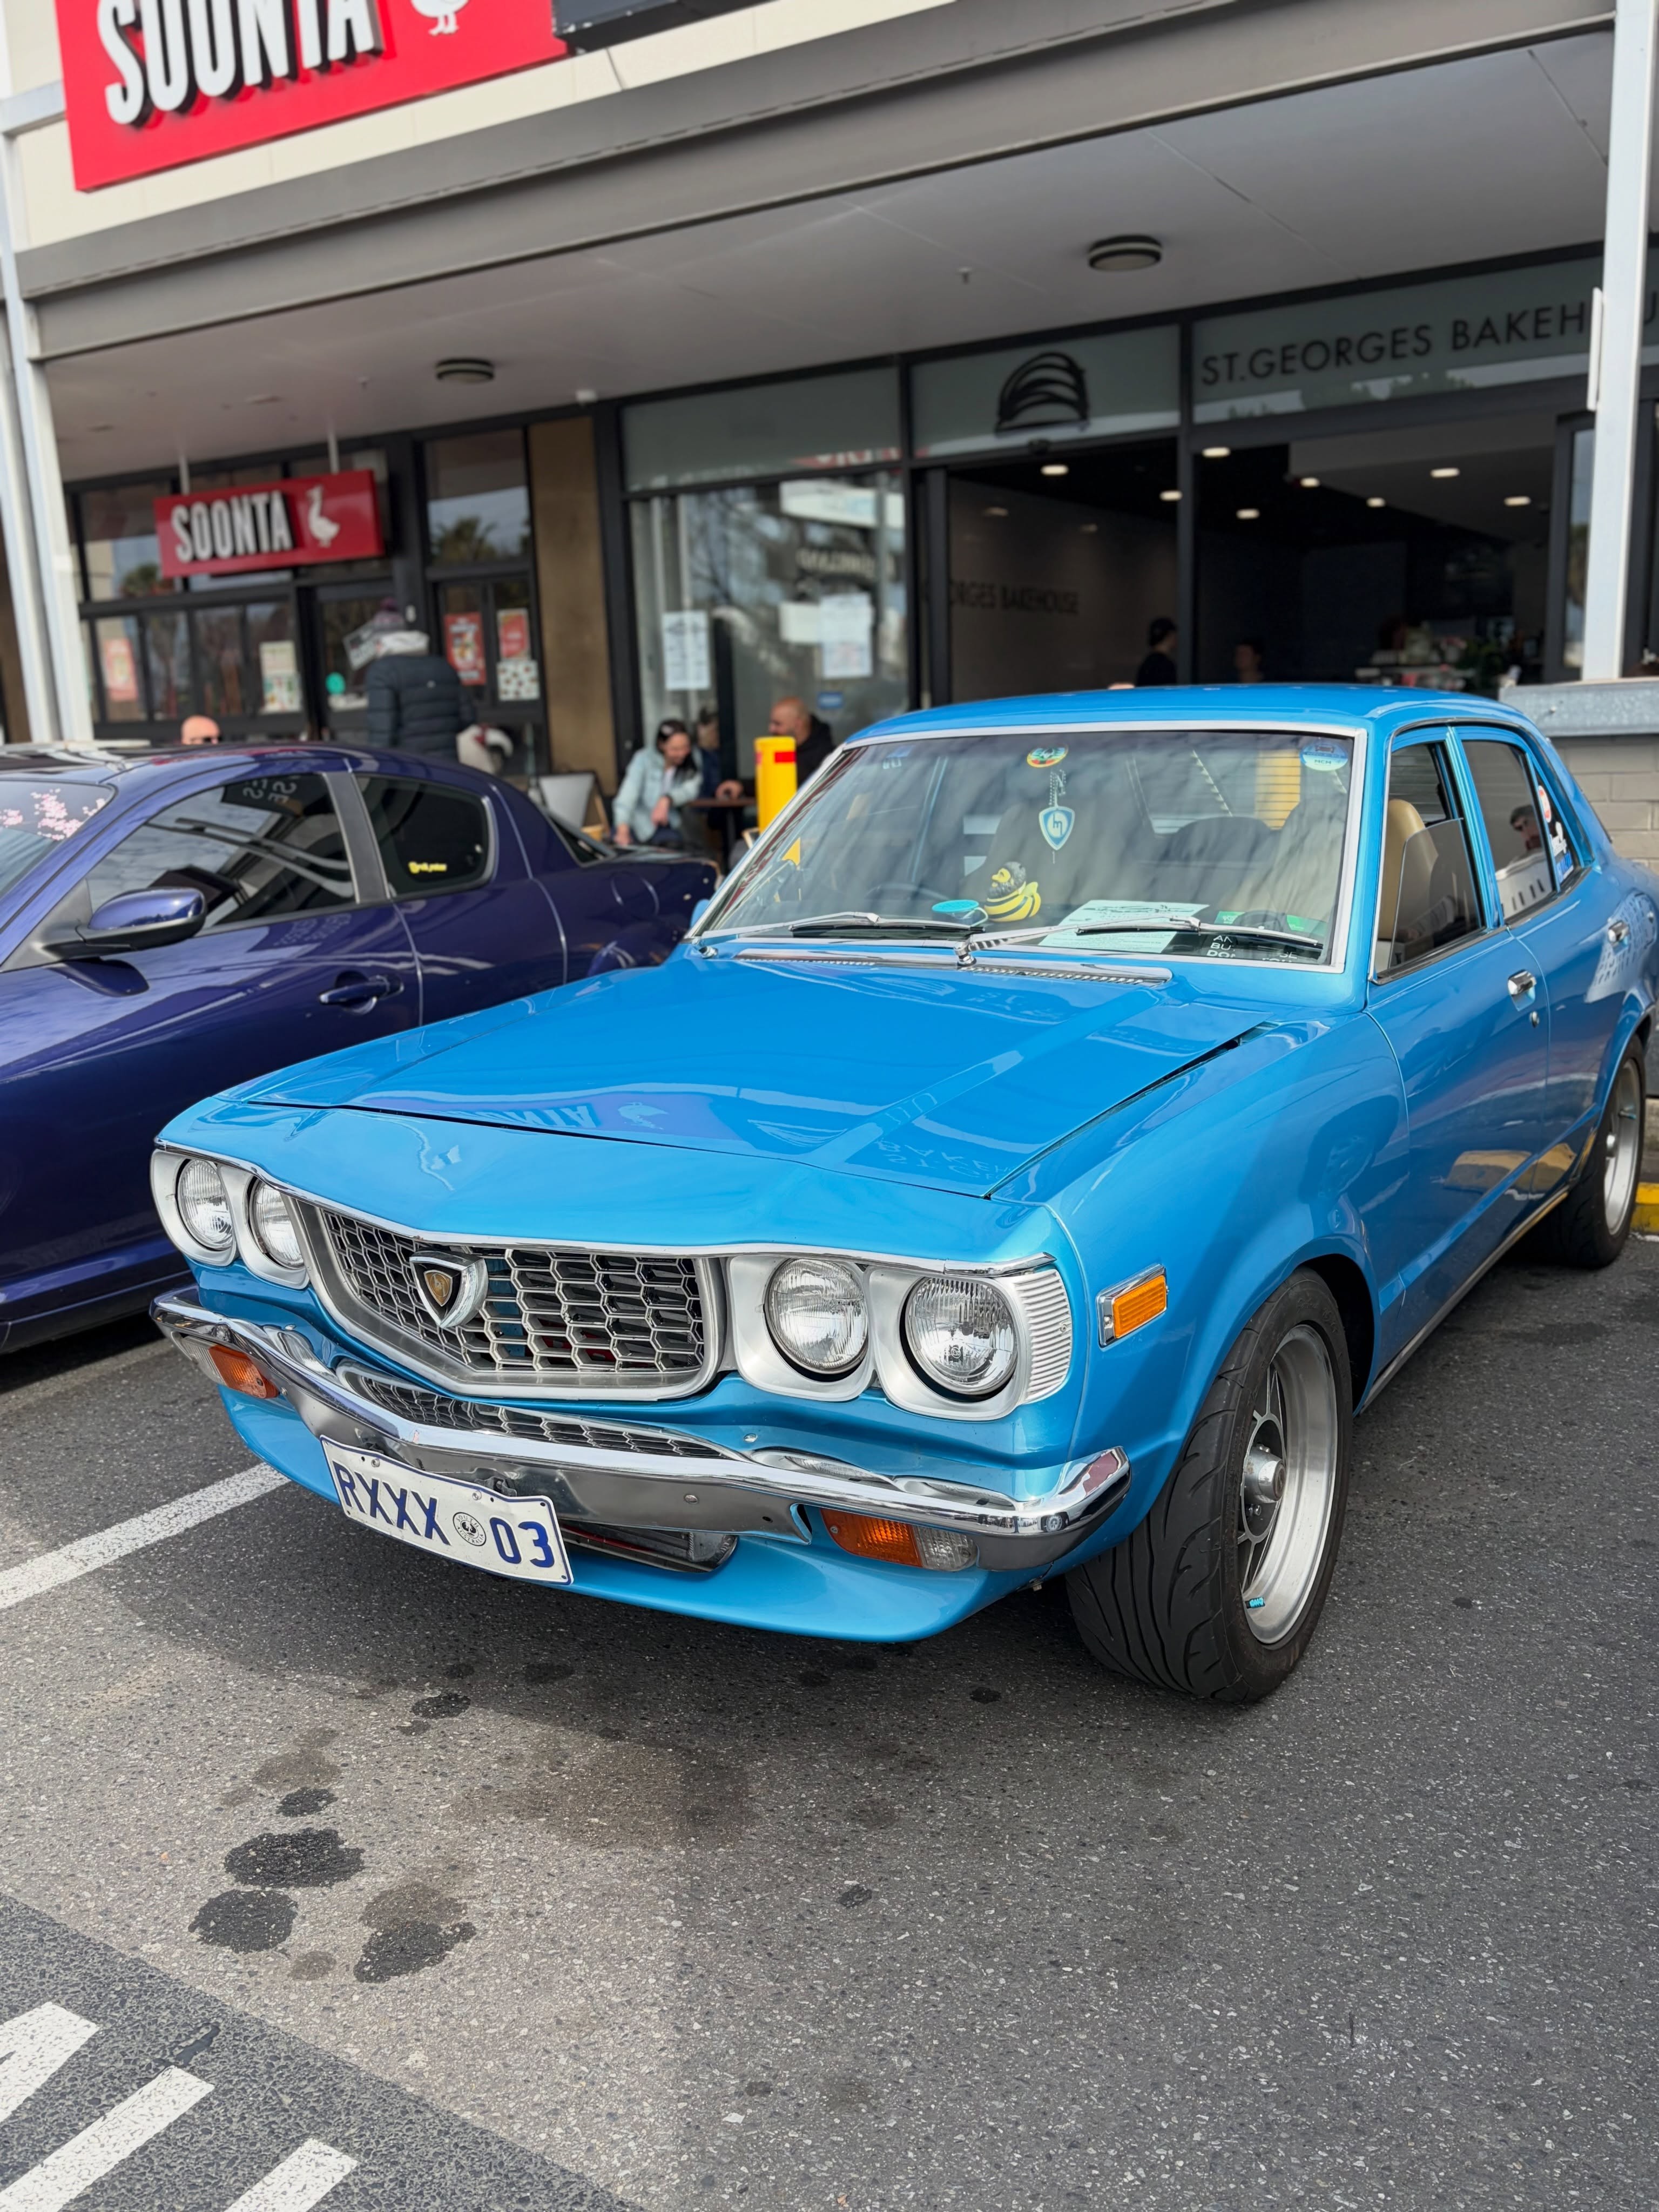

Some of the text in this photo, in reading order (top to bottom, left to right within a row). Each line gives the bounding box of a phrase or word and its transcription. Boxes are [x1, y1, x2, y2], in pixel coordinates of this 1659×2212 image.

[1451, 293, 1657, 352] BAKEH
[170, 489, 293, 563] SOONTA
[332, 1460, 555, 1568] RXXX 03
